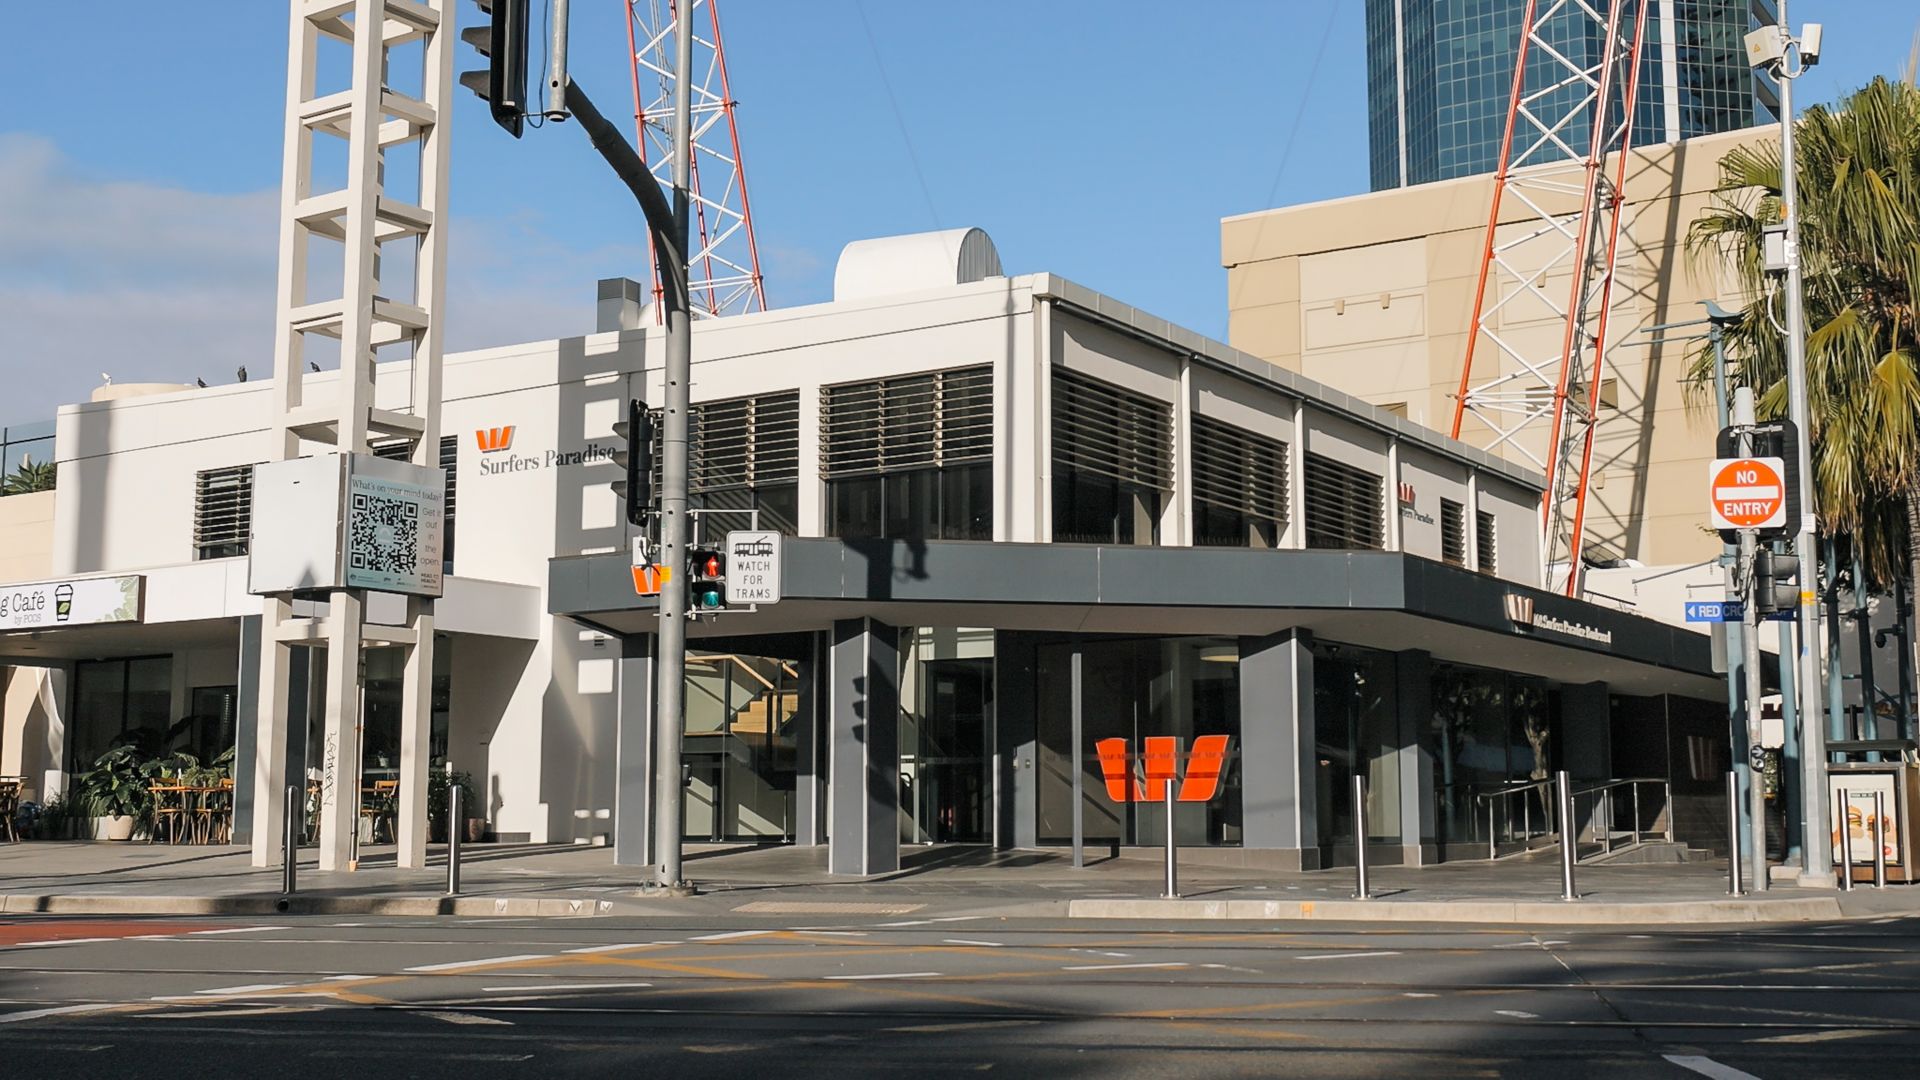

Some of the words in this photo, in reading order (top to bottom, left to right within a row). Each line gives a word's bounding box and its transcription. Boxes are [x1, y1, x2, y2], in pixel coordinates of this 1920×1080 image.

[480, 454, 539, 476] Surfers
[1736, 470, 1757, 484] NO
[352, 479, 375, 491] What's
[377, 484, 386, 492] on
[404, 488, 421, 498] mind
[422, 507, 435, 516] Get
[1723, 502, 1772, 516] ENTRY
[425, 521, 437, 529] out
[428, 533, 435, 541] in
[425, 544, 437, 553] the
[737, 561, 770, 571] WATCH
[743, 575, 763, 584] FOR
[736, 588, 771, 599] TRAMS
[12, 590, 46, 612] Café
[1698, 606, 1721, 617] RED
[1722, 605, 1745, 617] CRO
[14, 615, 23, 625] by
